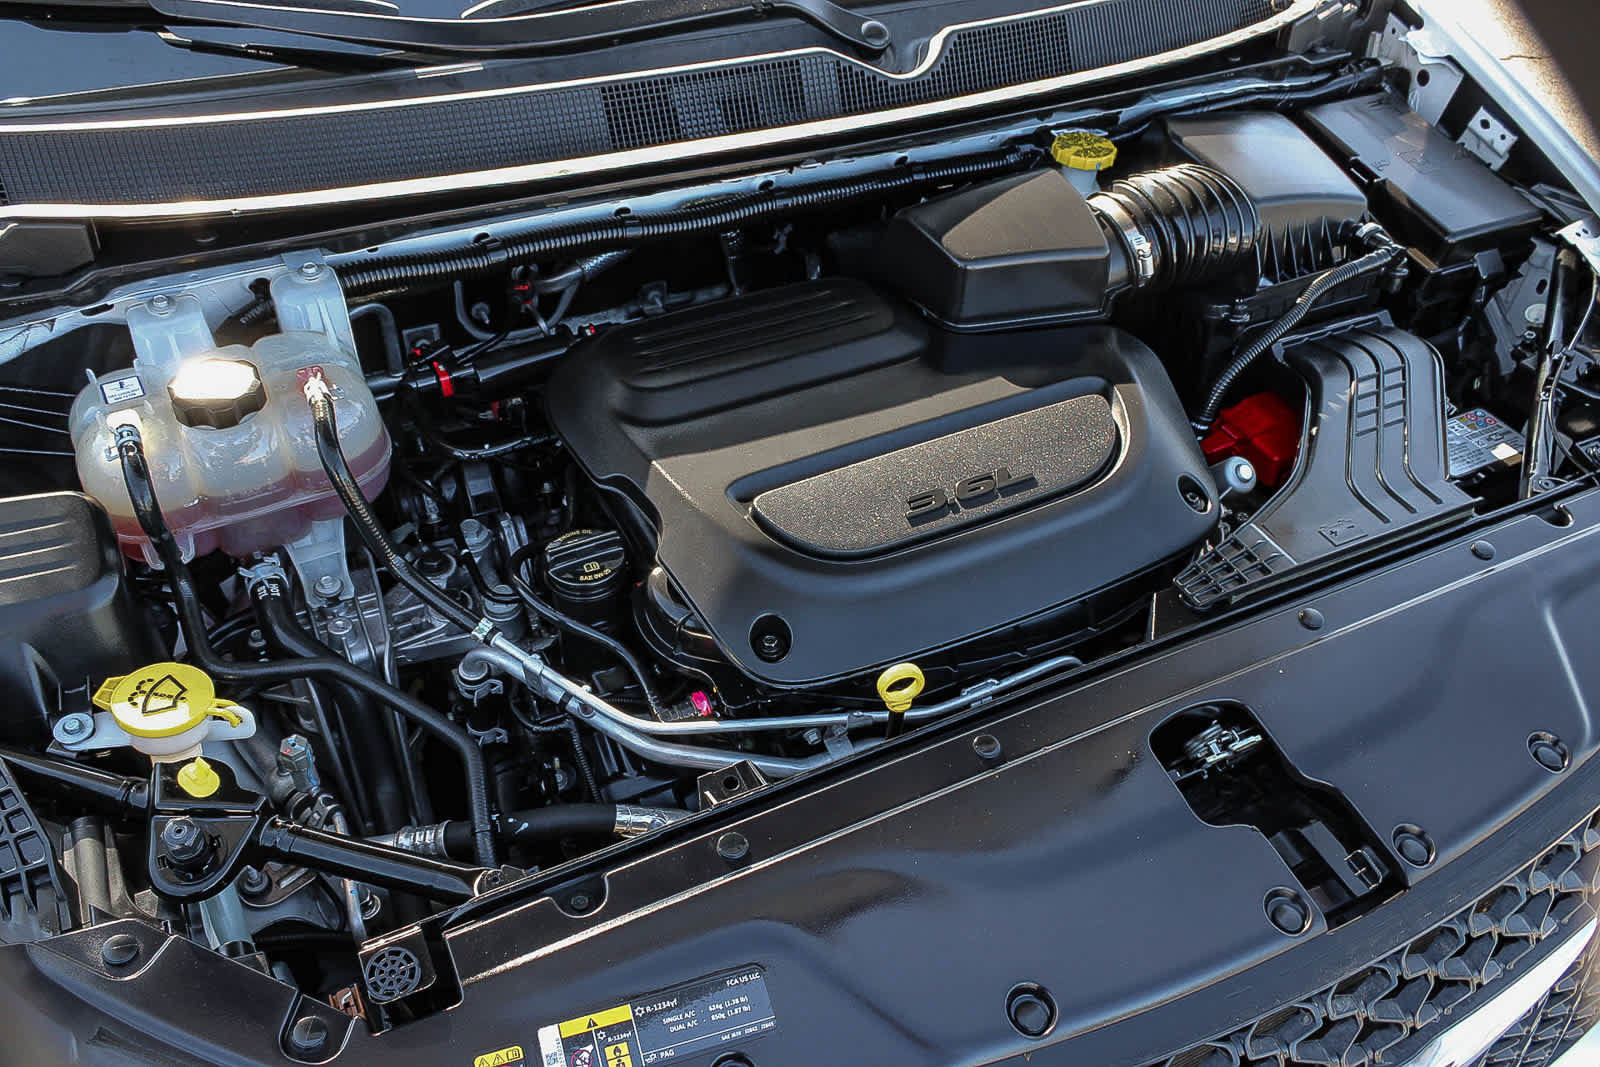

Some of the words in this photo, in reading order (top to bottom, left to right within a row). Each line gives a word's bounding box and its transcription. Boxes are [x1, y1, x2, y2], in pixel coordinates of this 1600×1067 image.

[904, 468, 1038, 523] 3.6L
[726, 978, 739, 987] FCA
[739, 975, 749, 983] US
[749, 972, 761, 980] LLC
[645, 998, 678, 1014] R-1234yf
[662, 1013, 684, 1025] SINGLE
[685, 1010, 696, 1019] A/C
[669, 1023, 686, 1033] DUAL
[687, 1020, 698, 1029] A/C
[660, 1050, 675, 1059] PAG
